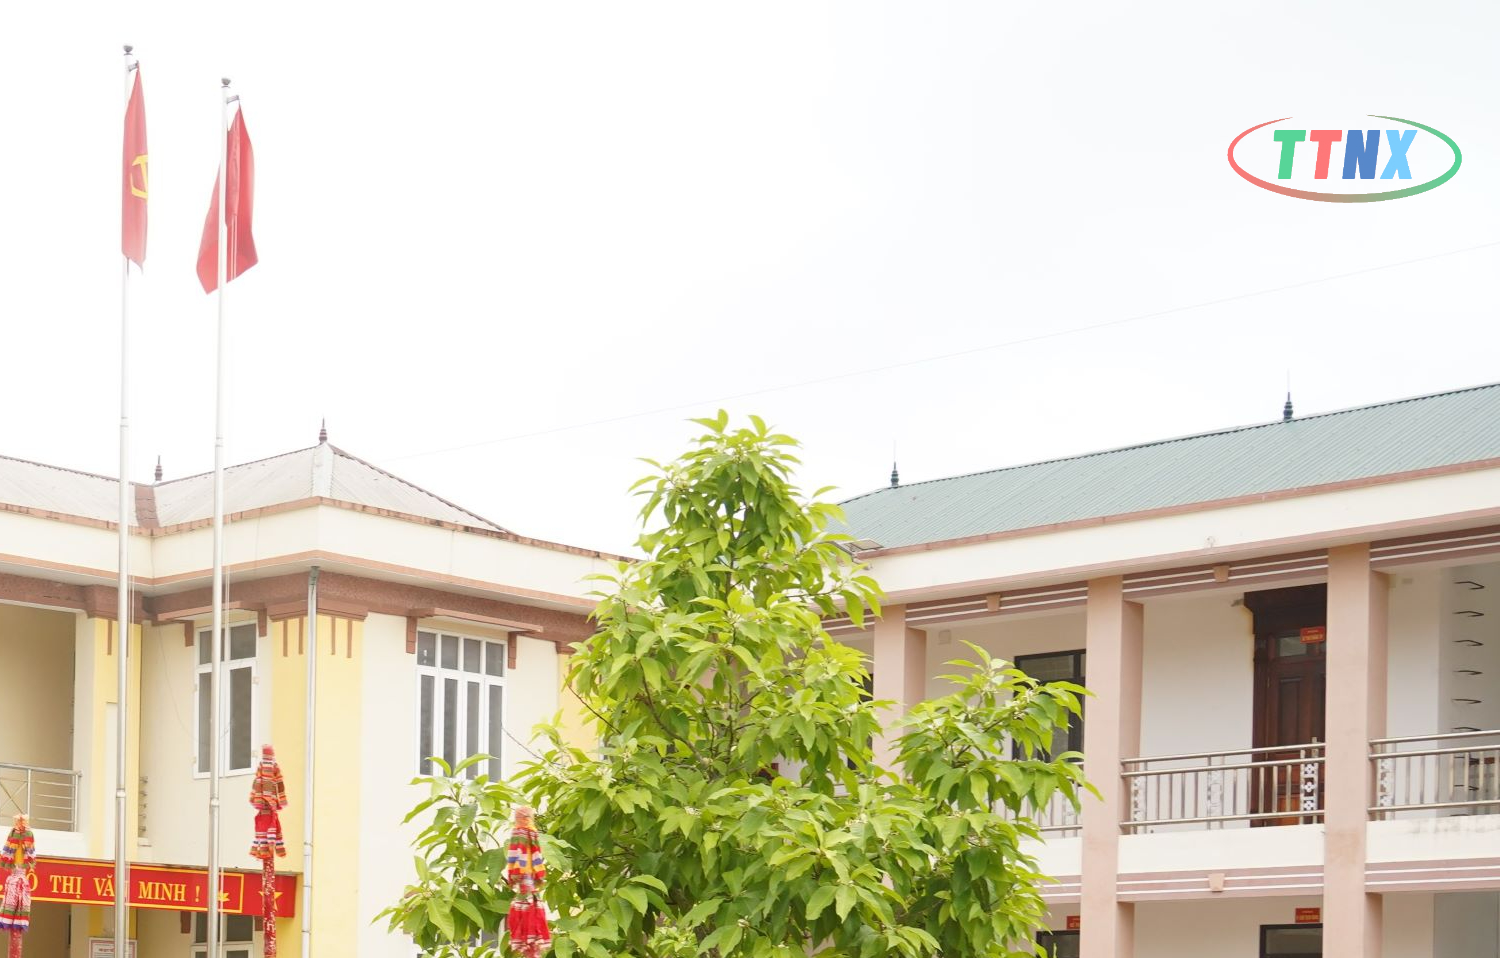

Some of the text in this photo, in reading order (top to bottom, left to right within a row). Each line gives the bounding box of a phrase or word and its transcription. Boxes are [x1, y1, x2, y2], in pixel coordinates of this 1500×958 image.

[50, 874, 83, 899] THỊ
[92, 874, 130, 897] VĂ
[138, 880, 187, 902] MINH
[194, 885, 201, 902] !
